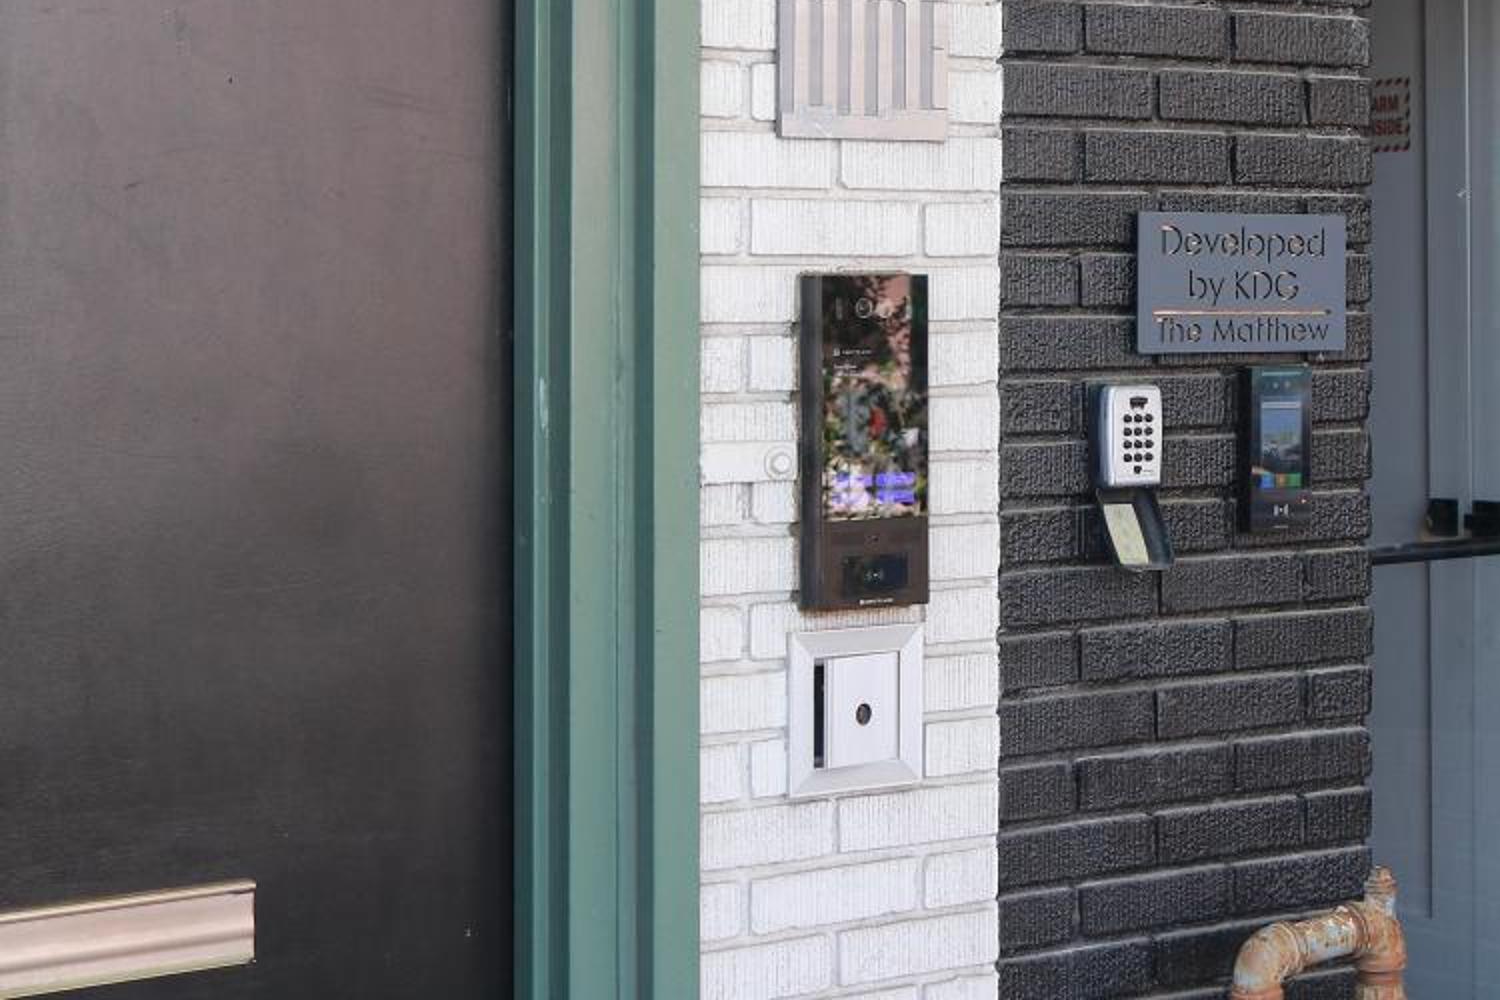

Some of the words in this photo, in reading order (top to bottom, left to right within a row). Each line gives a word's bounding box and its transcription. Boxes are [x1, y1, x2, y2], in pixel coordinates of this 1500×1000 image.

[1159, 224, 1326, 265] Developed
[1188, 269, 1226, 307] by
[1234, 270, 1300, 301] KDG
[1156, 317, 1203, 343] The
[1212, 317, 1330, 343] Matthew
